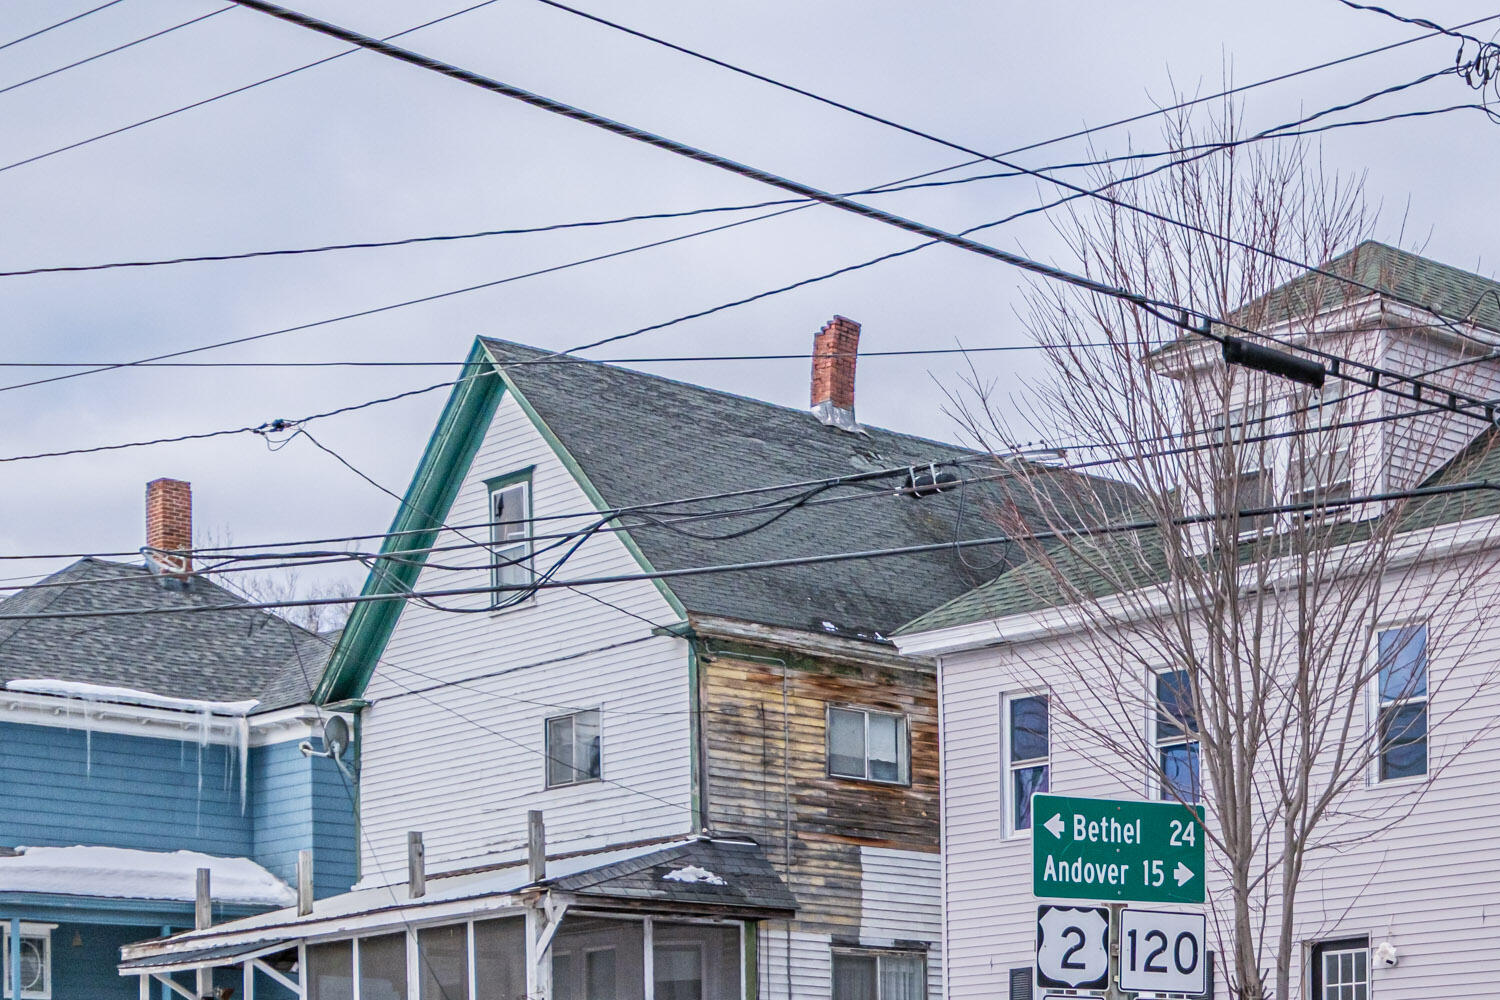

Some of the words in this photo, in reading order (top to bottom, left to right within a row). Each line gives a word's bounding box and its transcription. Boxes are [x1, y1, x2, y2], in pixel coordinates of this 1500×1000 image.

[1073, 813, 1141, 844] Bethel
[1169, 819, 1196, 847] 24
[1043, 855, 1129, 885] Andover
[1142, 860, 1165, 887] 15
[1061, 925, 1086, 970] 2
[1127, 929, 1198, 975] 120
